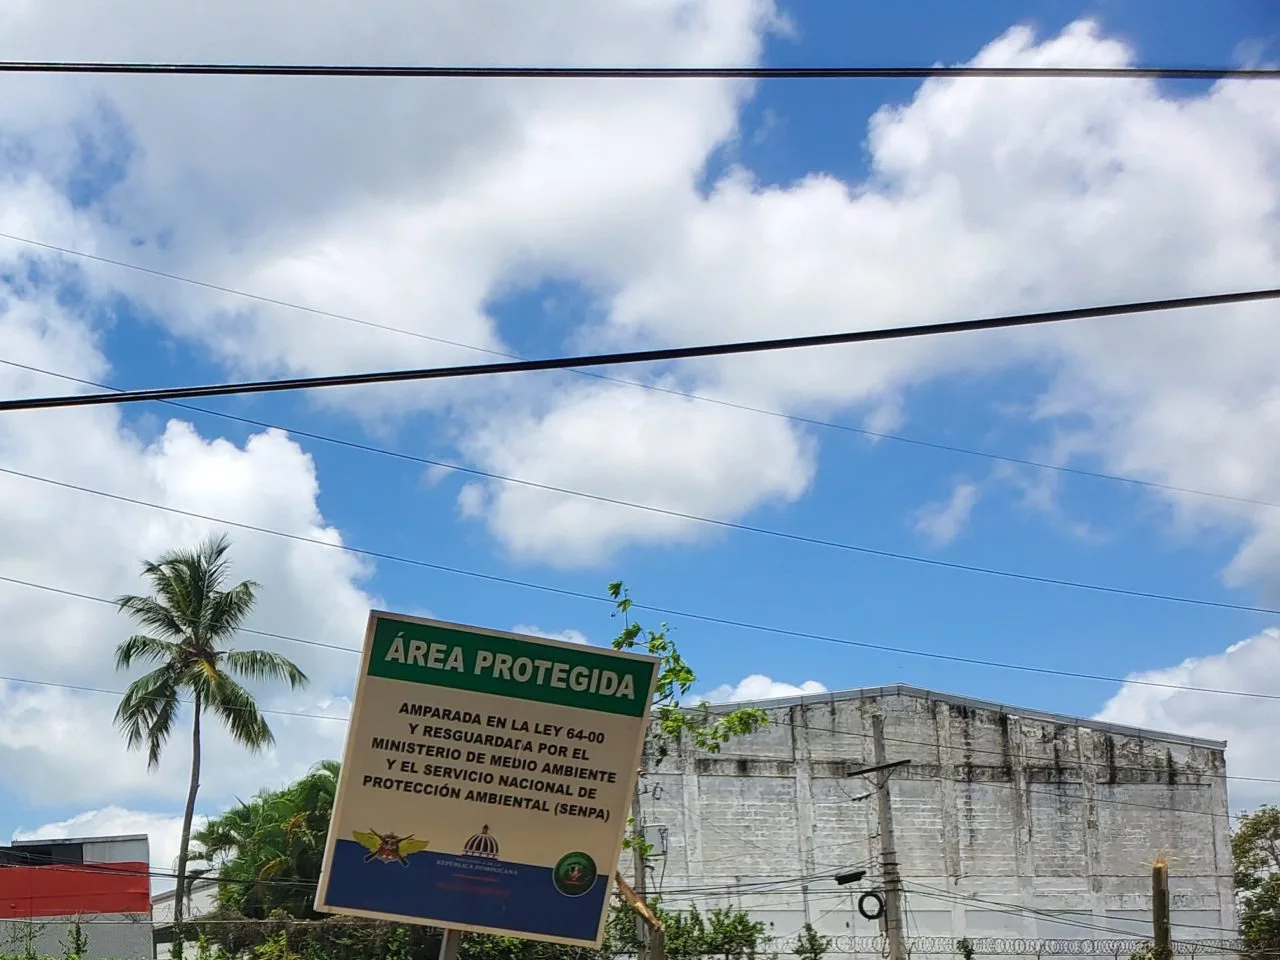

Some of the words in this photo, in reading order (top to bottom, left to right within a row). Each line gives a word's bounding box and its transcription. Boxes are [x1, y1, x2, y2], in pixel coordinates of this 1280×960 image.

[384, 632, 464, 672] ÁREA
[473, 650, 635, 700] PROTEGIDA
[399, 702, 481, 726] AMPARADA
[487, 716, 506, 729] EN
[511, 719, 529, 733] LA
[534, 723, 563, 737] LEY
[567, 727, 605, 744] 64-00
[409, 723, 419, 734] Y
[423, 726, 533, 752] RESGUARDADA
[538, 743, 568, 757] POR
[572, 749, 589, 760] EL
[371, 737, 461, 760] MINISTERIO
[466, 751, 485, 764] DE
[490, 755, 537, 771] MEDIO
[542, 763, 617, 784] AMBIENTE
[386, 758, 396, 770] Y
[401, 761, 418, 773] EL
[423, 764, 494, 784] SERVICIO
[499, 775, 573, 796] NACIONAL
[578, 786, 597, 799] DE
[363, 775, 461, 799] PROTECCIÓN
[465, 790, 550, 812] AMBIENTAL
[554, 802, 610, 823] (SENPA)
